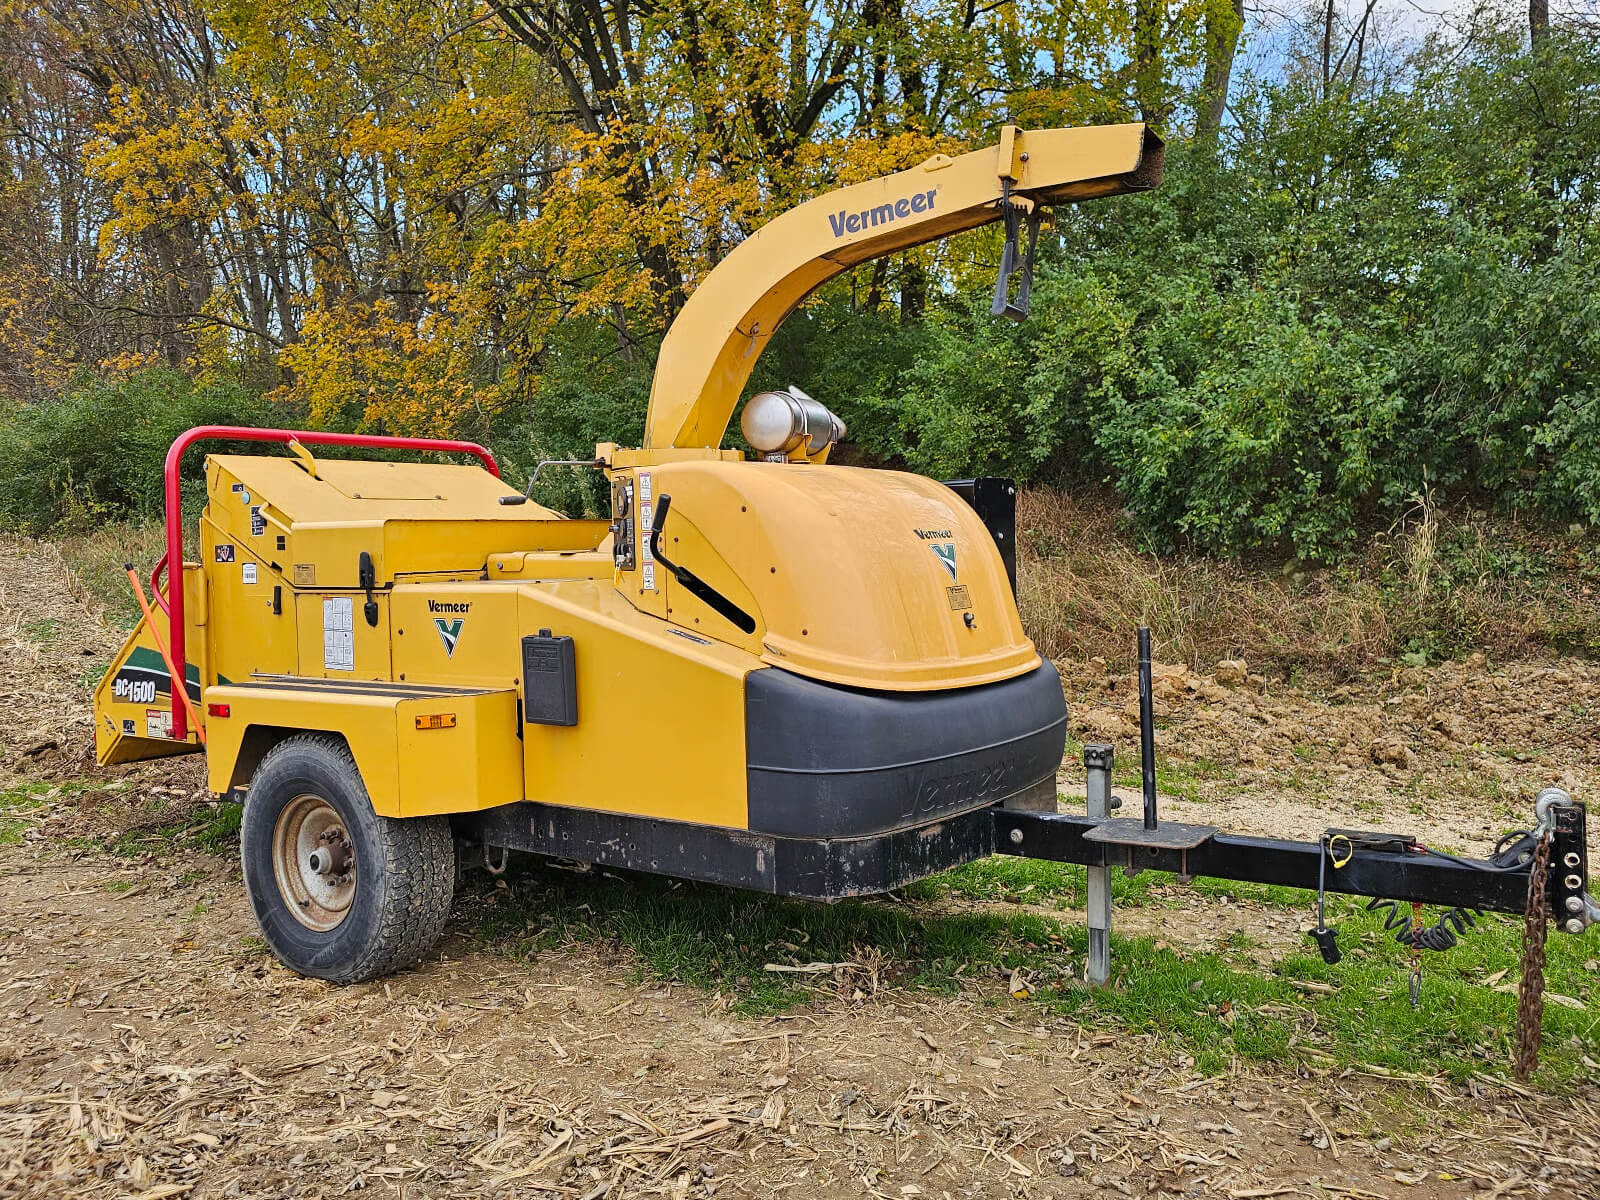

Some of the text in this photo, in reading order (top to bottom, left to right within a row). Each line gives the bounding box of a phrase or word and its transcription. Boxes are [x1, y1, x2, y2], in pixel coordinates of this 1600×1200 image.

[828, 189, 937, 238] Vermeer
[913, 528, 953, 540] Vermeer
[428, 599, 470, 613] Vermeer
[115, 678, 155, 703] BC1500
